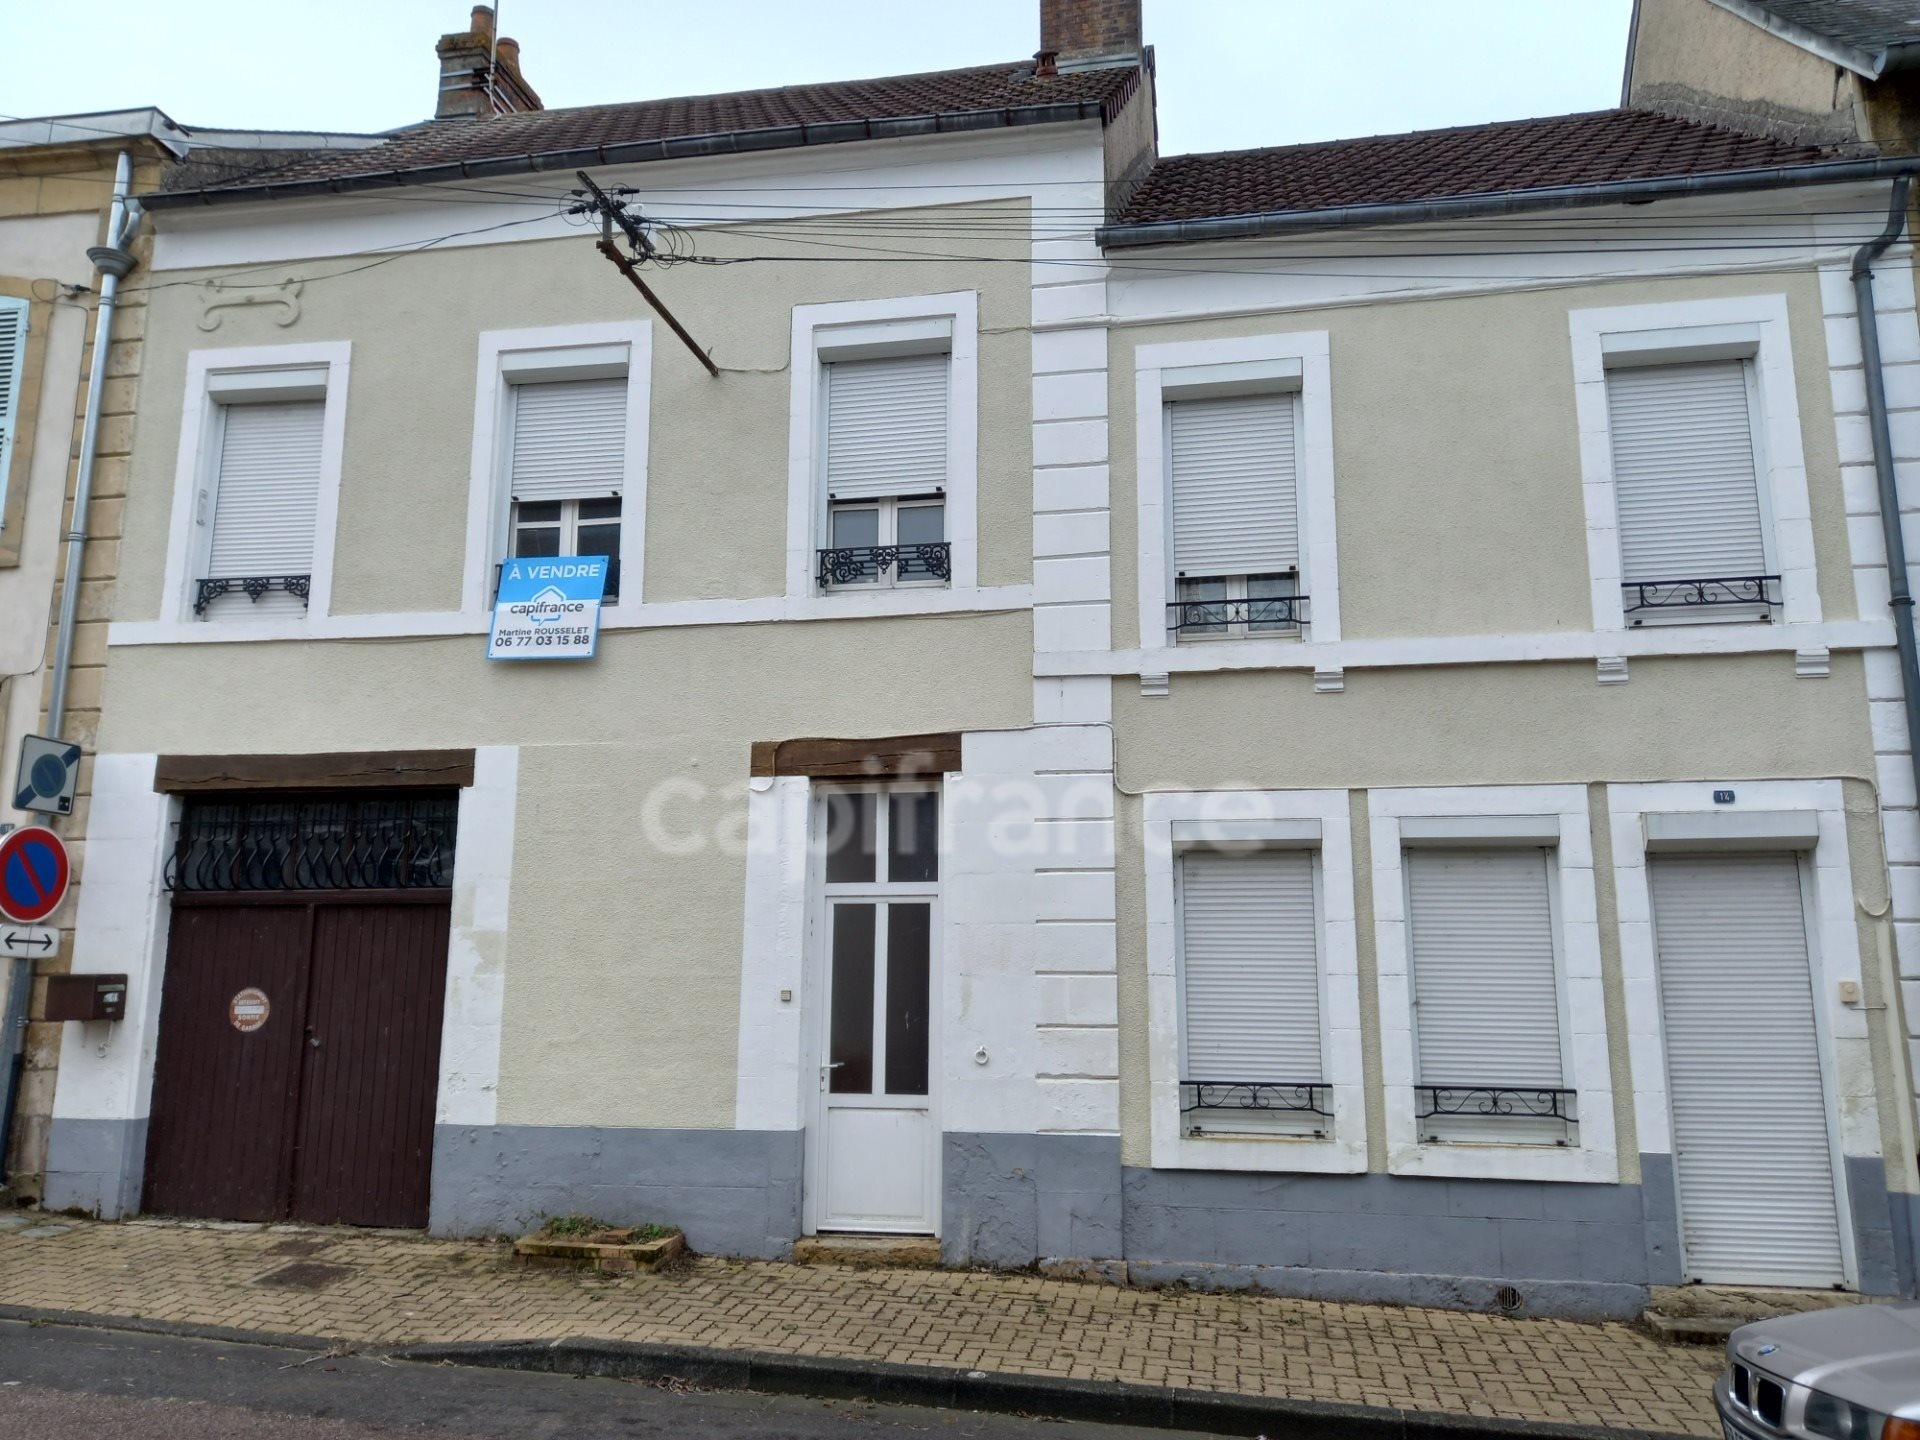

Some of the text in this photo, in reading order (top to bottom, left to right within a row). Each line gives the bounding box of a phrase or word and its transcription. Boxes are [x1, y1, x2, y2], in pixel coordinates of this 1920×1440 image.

[508, 563, 601, 580] À VENDRE
[510, 601, 584, 616] capifrance
[499, 627, 589, 637] Martine ROUSSELET
[495, 635, 590, 647] 06 77 03 15 88
